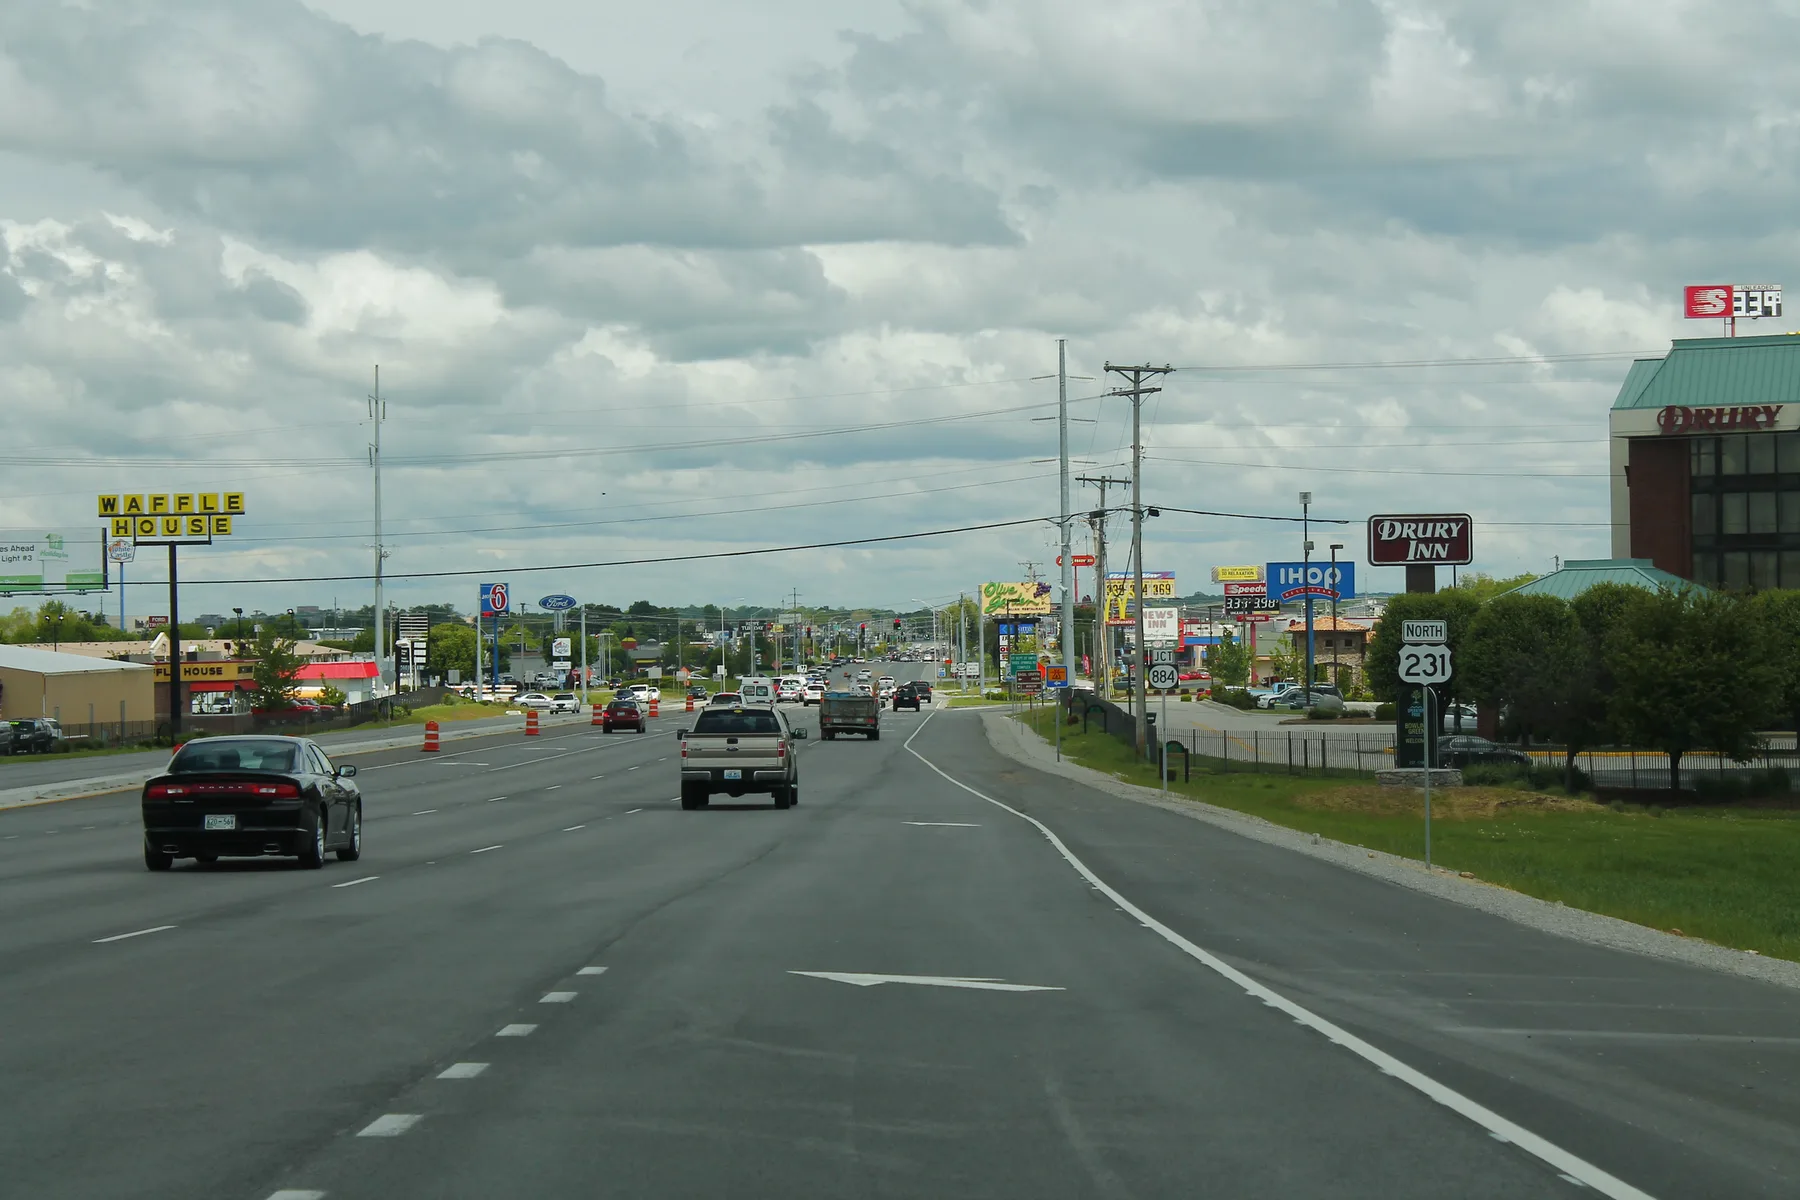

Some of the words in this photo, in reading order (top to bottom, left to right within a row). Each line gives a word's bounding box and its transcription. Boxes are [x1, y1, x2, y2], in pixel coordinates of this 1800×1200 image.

[1657, 404, 1784, 433] DRURY
[101, 494, 240, 513] WAFFLE
[115, 518, 228, 535] HOUSE
[1377, 520, 1464, 541] DRURY
[0, 545, 8, 553] es
[11, 544, 35, 552] Ahead
[1406, 539, 1450, 561] INN
[2, 555, 20, 564] Light
[1279, 567, 1342, 589] IHOP
[489, 583, 508, 611] 6
[984, 582, 1018, 598] Olive
[1228, 585, 1267, 595] Speedw
[1284, 588, 1333, 597] RESTURAN
[546, 597, 569, 608] Ford
[1148, 620, 1166, 628] INN
[1406, 623, 1443, 638] NORTH
[1154, 651, 1173, 662] JCT
[184, 667, 223, 676] HOUSE
[1405, 653, 1446, 677] 231
[1152, 669, 1175, 684] 884
